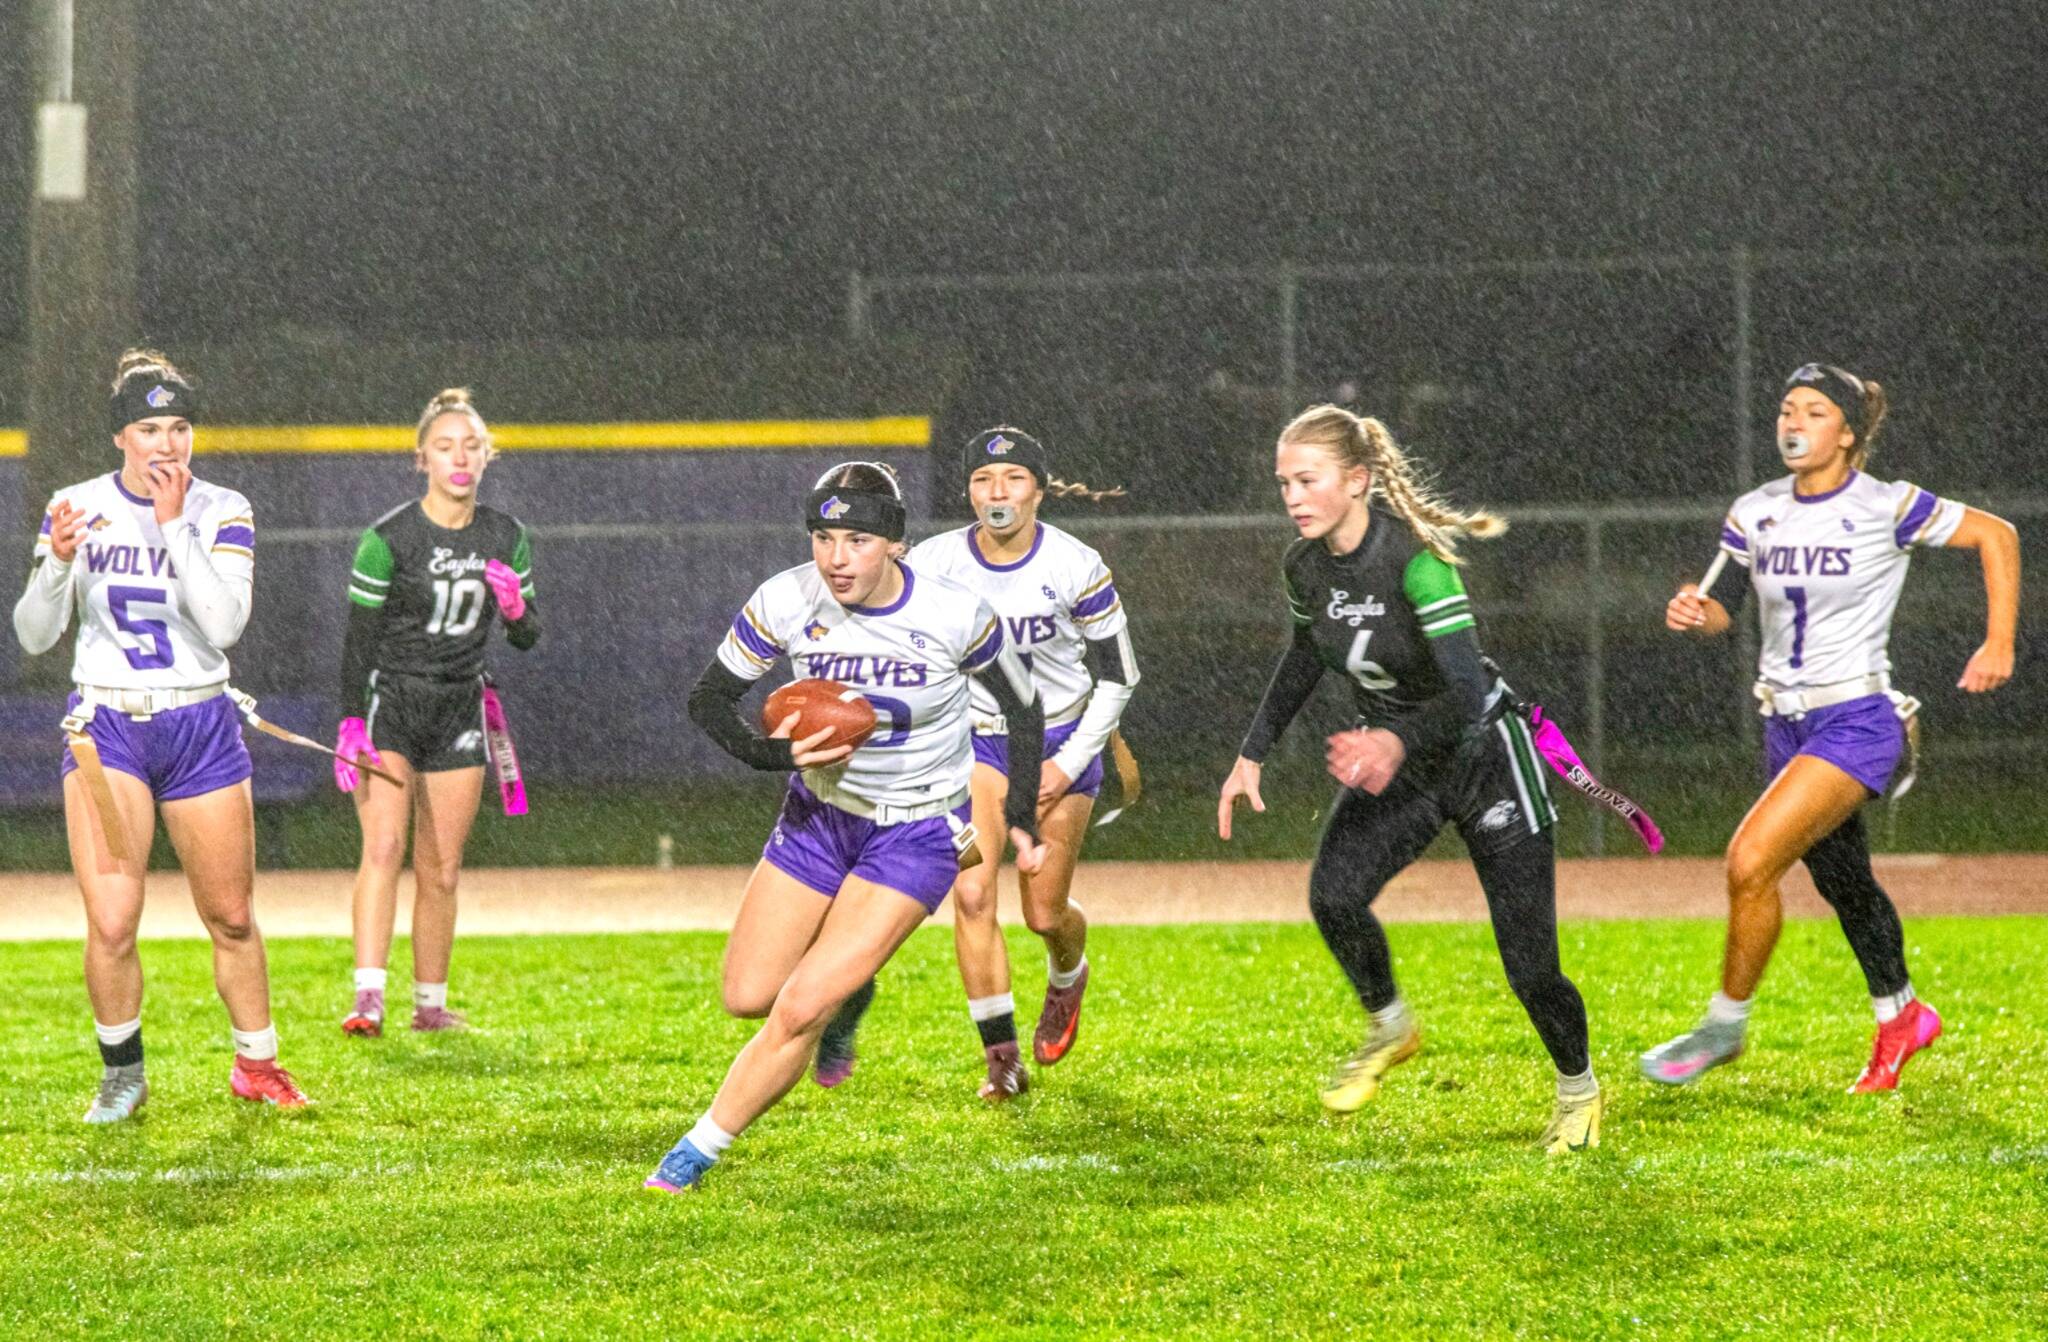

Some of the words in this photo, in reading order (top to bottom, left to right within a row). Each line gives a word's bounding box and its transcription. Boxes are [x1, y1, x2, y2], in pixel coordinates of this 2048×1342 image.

[85, 542, 179, 580] WOLV
[428, 546, 487, 579] Eagles
[1755, 545, 1853, 576] WOLVES
[426, 579, 486, 636] 10
[1326, 587, 1387, 627] Eagles
[1783, 585, 1808, 669] 1
[107, 584, 176, 671] 5
[1006, 614, 1057, 646] VES
[807, 652, 928, 688] WOLVES
[1345, 629, 1398, 691] 6
[1566, 764, 1638, 819] EAGLES
